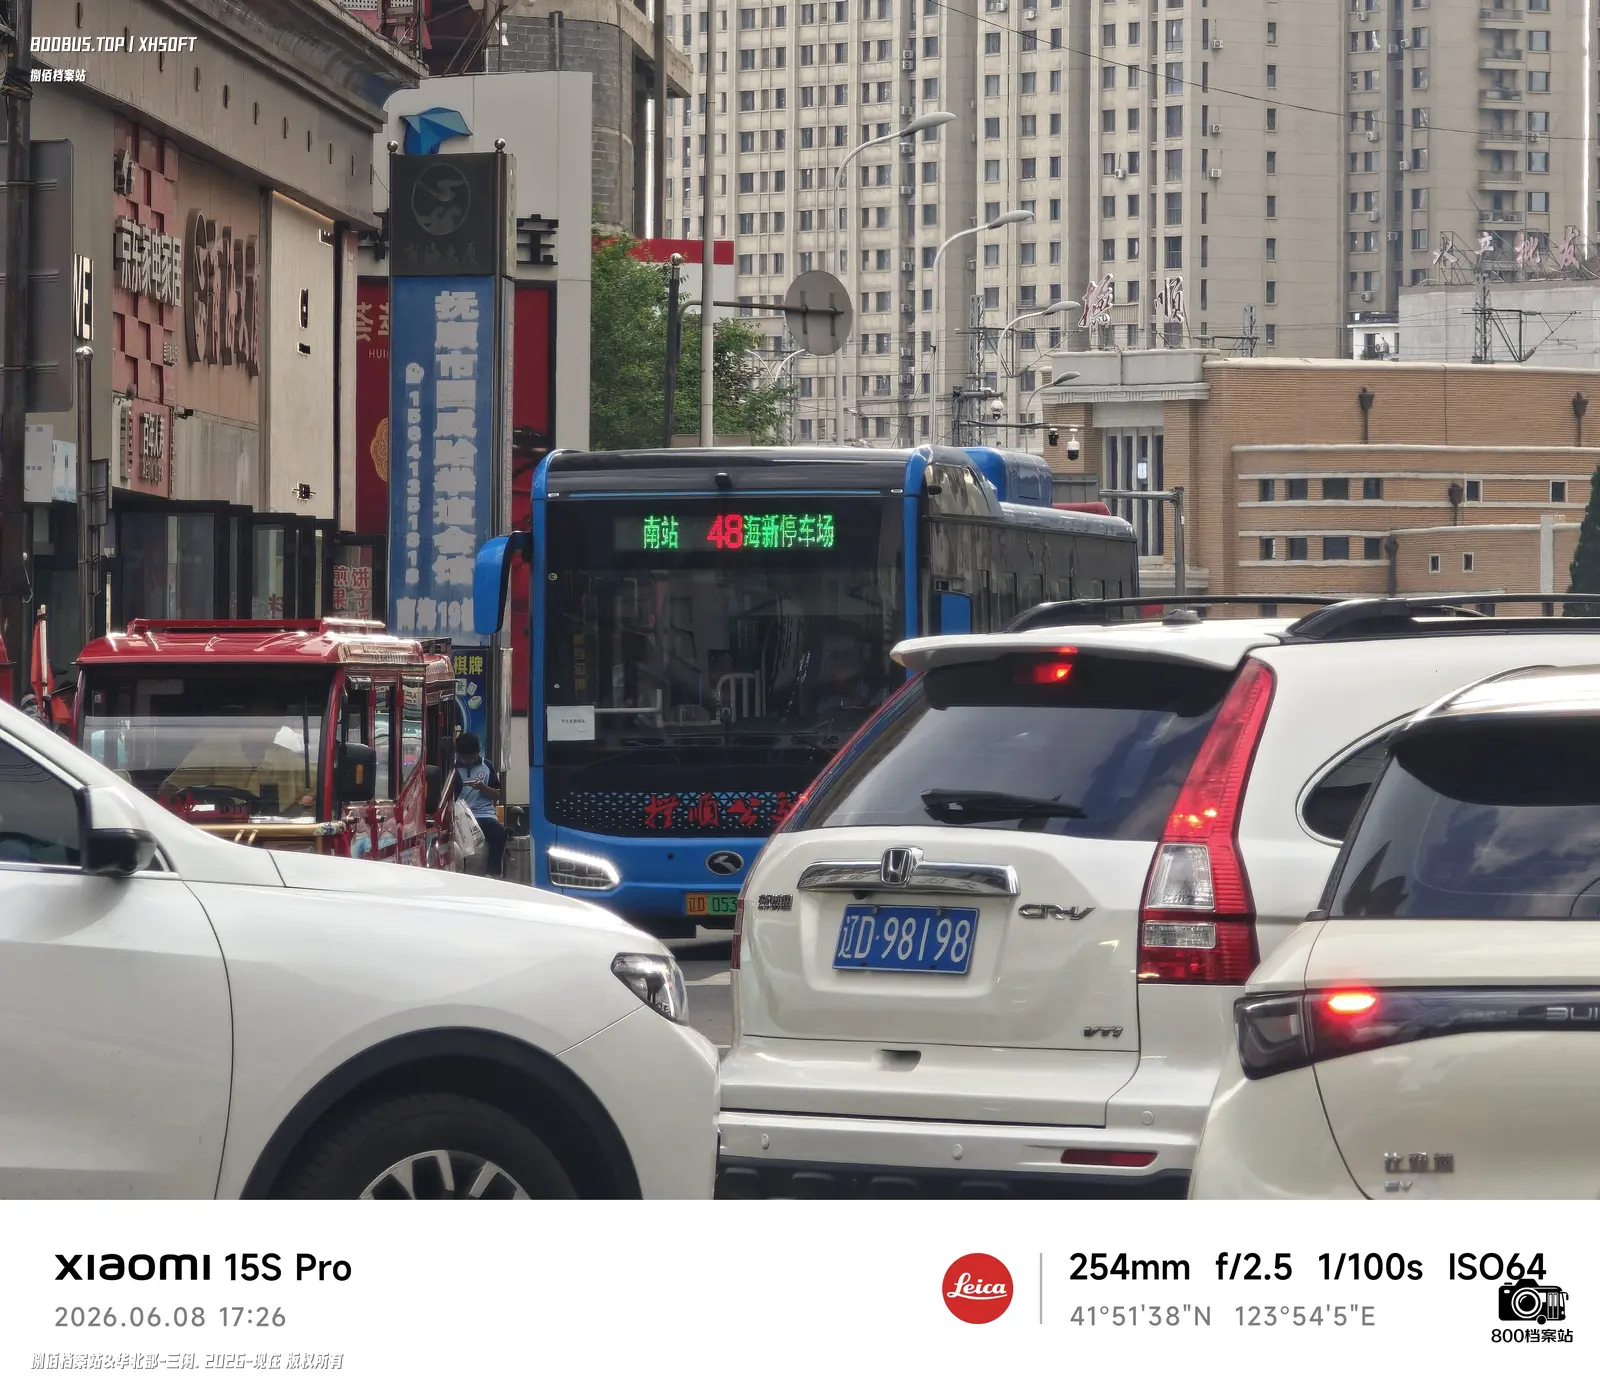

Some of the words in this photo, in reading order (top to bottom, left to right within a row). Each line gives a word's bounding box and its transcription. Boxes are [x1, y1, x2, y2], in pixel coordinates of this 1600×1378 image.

[116, 215, 182, 307] 京东家电家居
[368, 348, 389, 359] HUI
[643, 515, 679, 549] 南站
[707, 514, 743, 549] 48
[743, 513, 835, 548] 海新停车场
[454, 656, 483, 675] 棋牌
[1019, 903, 1097, 921] CR-V
